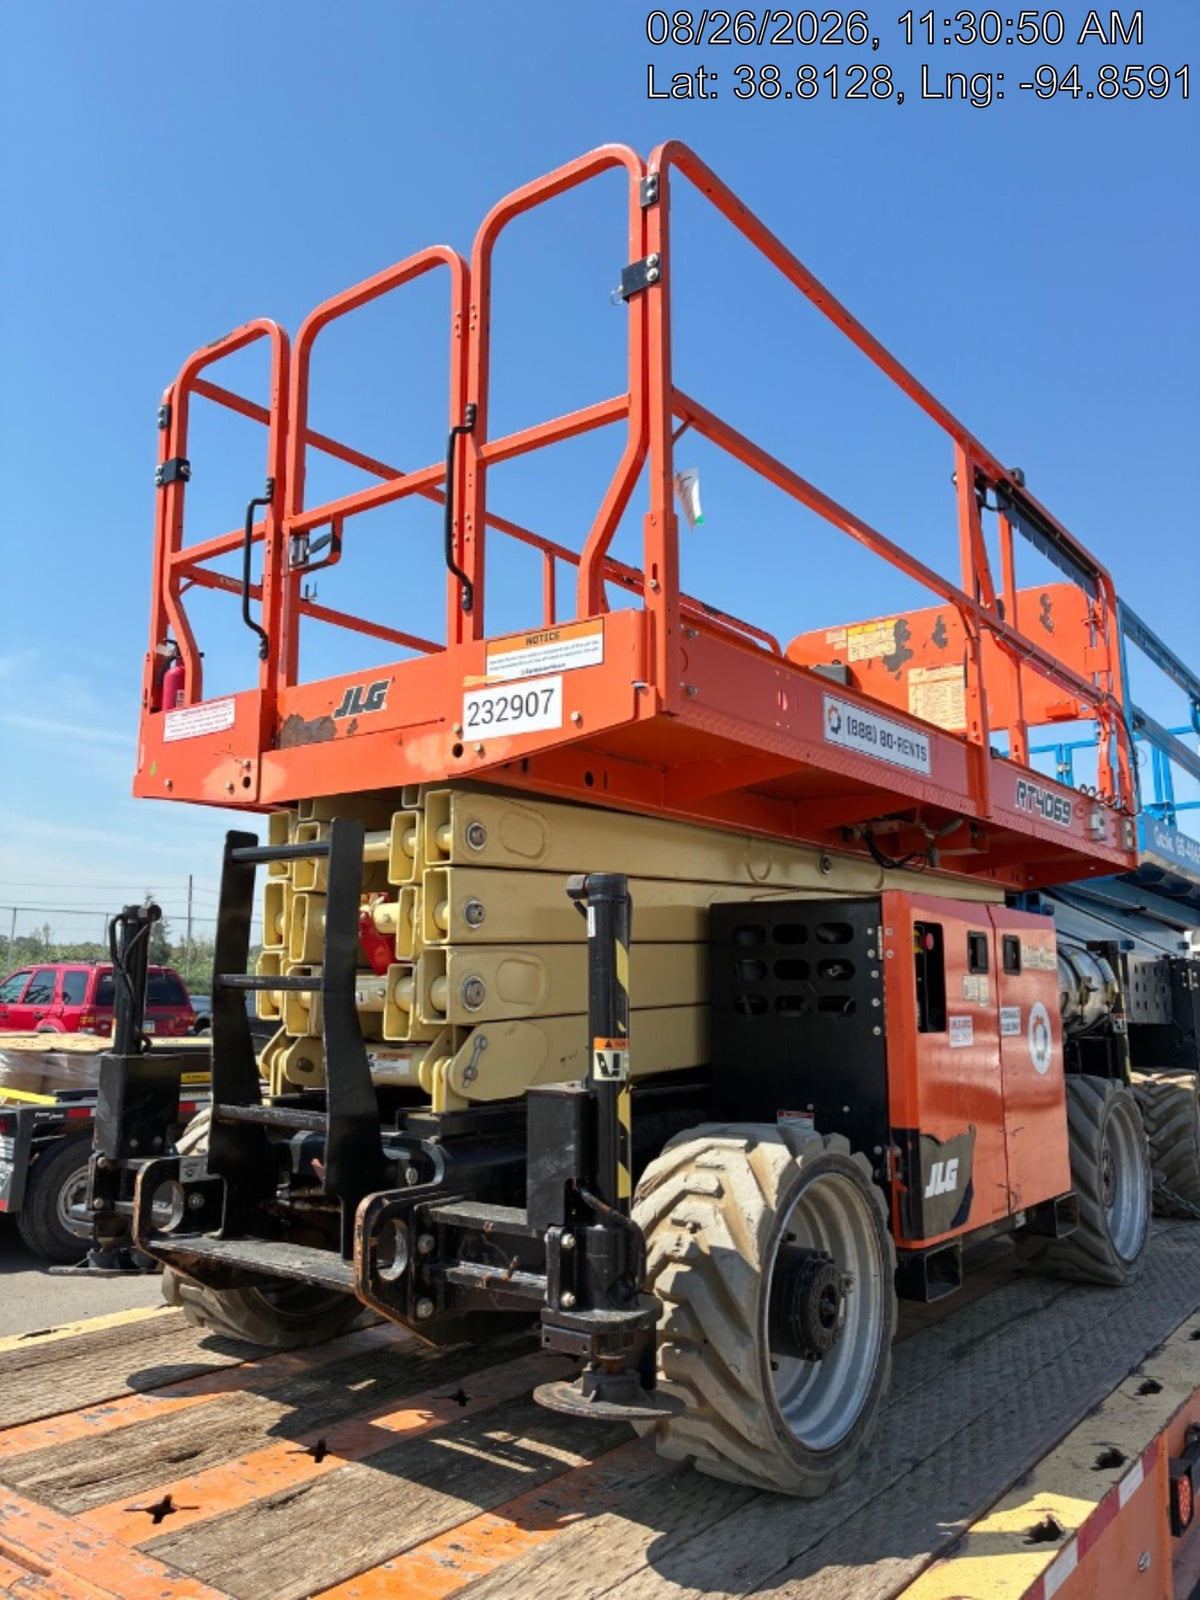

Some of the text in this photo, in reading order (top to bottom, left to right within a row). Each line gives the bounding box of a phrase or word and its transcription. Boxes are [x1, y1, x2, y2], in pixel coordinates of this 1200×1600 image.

[525, 631, 561, 646] NOTICE
[332, 679, 391, 718] JLG
[467, 688, 555, 727] 232907
[847, 716, 927, 761] (888) 80-RENTS
[1016, 779, 1072, 827] RT4069
[924, 1157, 959, 1199] JLG
